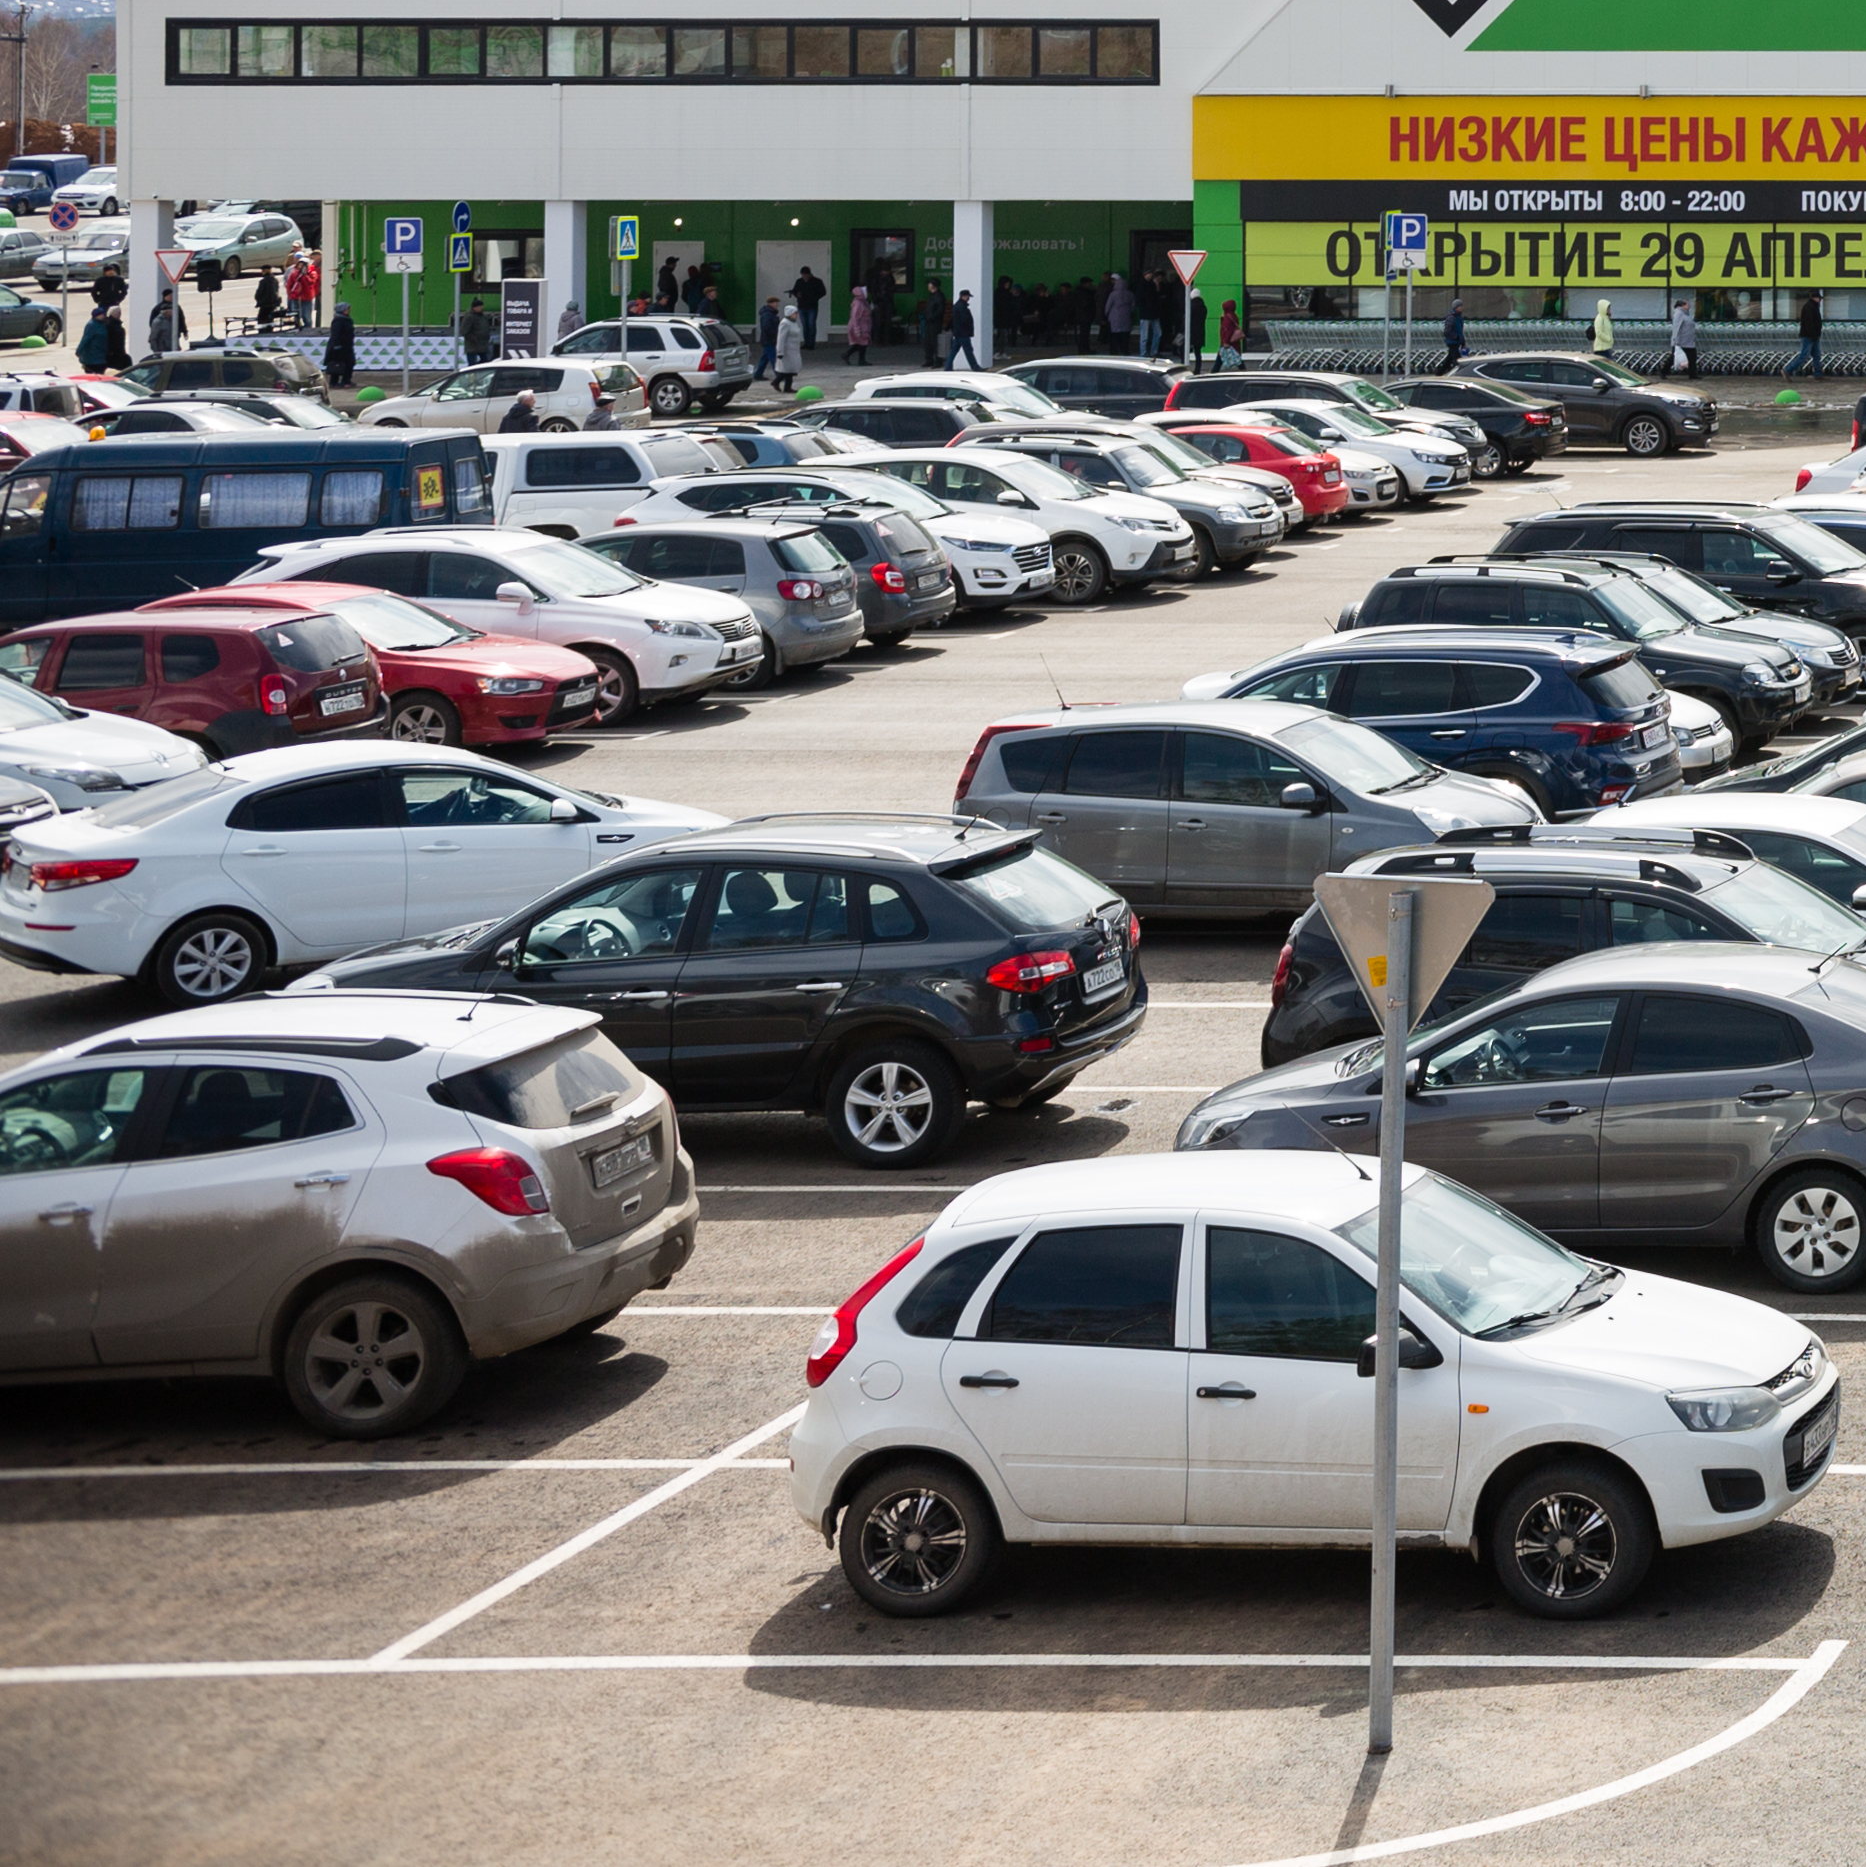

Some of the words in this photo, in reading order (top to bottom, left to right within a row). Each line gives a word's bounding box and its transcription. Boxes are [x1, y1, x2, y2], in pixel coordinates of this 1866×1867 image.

[1389, 115, 1587, 163] НИЗКИЕ
[1604, 116, 1746, 172] ЦЕНЫ
[1449, 189, 1488, 211] МЫ
[1494, 189, 1603, 212] ОТКРЫТЫ
[1620, 190, 1666, 212] 8:00
[1687, 190, 1746, 212] 22:00
[925, 236, 954, 253] Доб
[1326, 230, 1622, 277] ОТРЫТИЕ
[1640, 231, 1705, 279] 29
